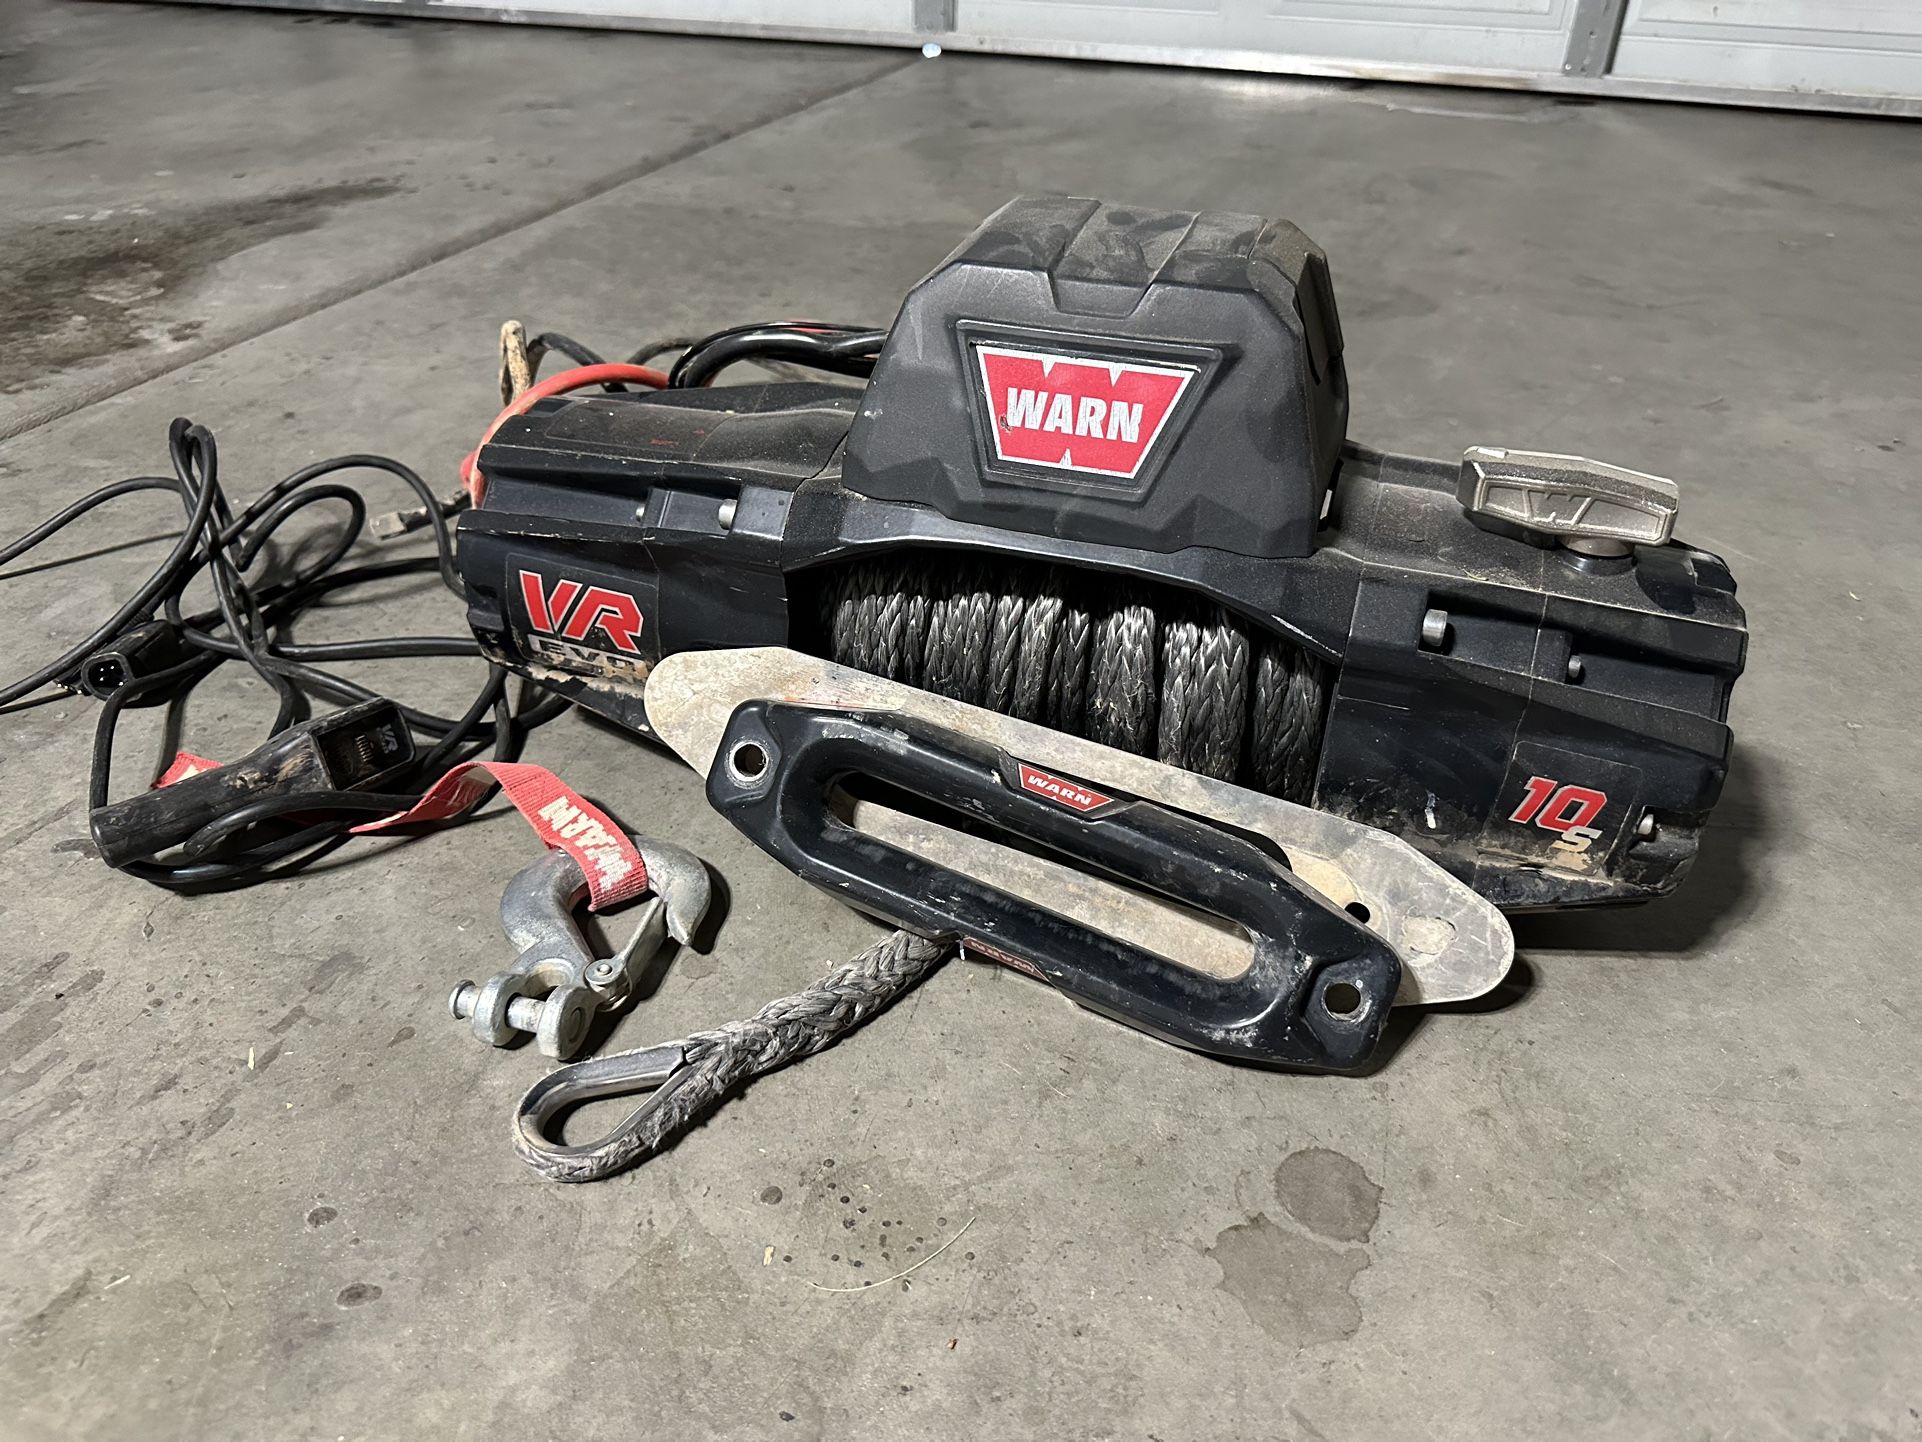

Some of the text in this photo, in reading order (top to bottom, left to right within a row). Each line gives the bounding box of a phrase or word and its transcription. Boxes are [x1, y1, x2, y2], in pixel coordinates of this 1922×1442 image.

[1006, 387, 1144, 443] WARN
[519, 569, 644, 655] VR
[1027, 774, 1092, 806] WARN
[1508, 776, 1608, 833] 10
[538, 795, 632, 894] WARN
[1551, 825, 1603, 853] S
